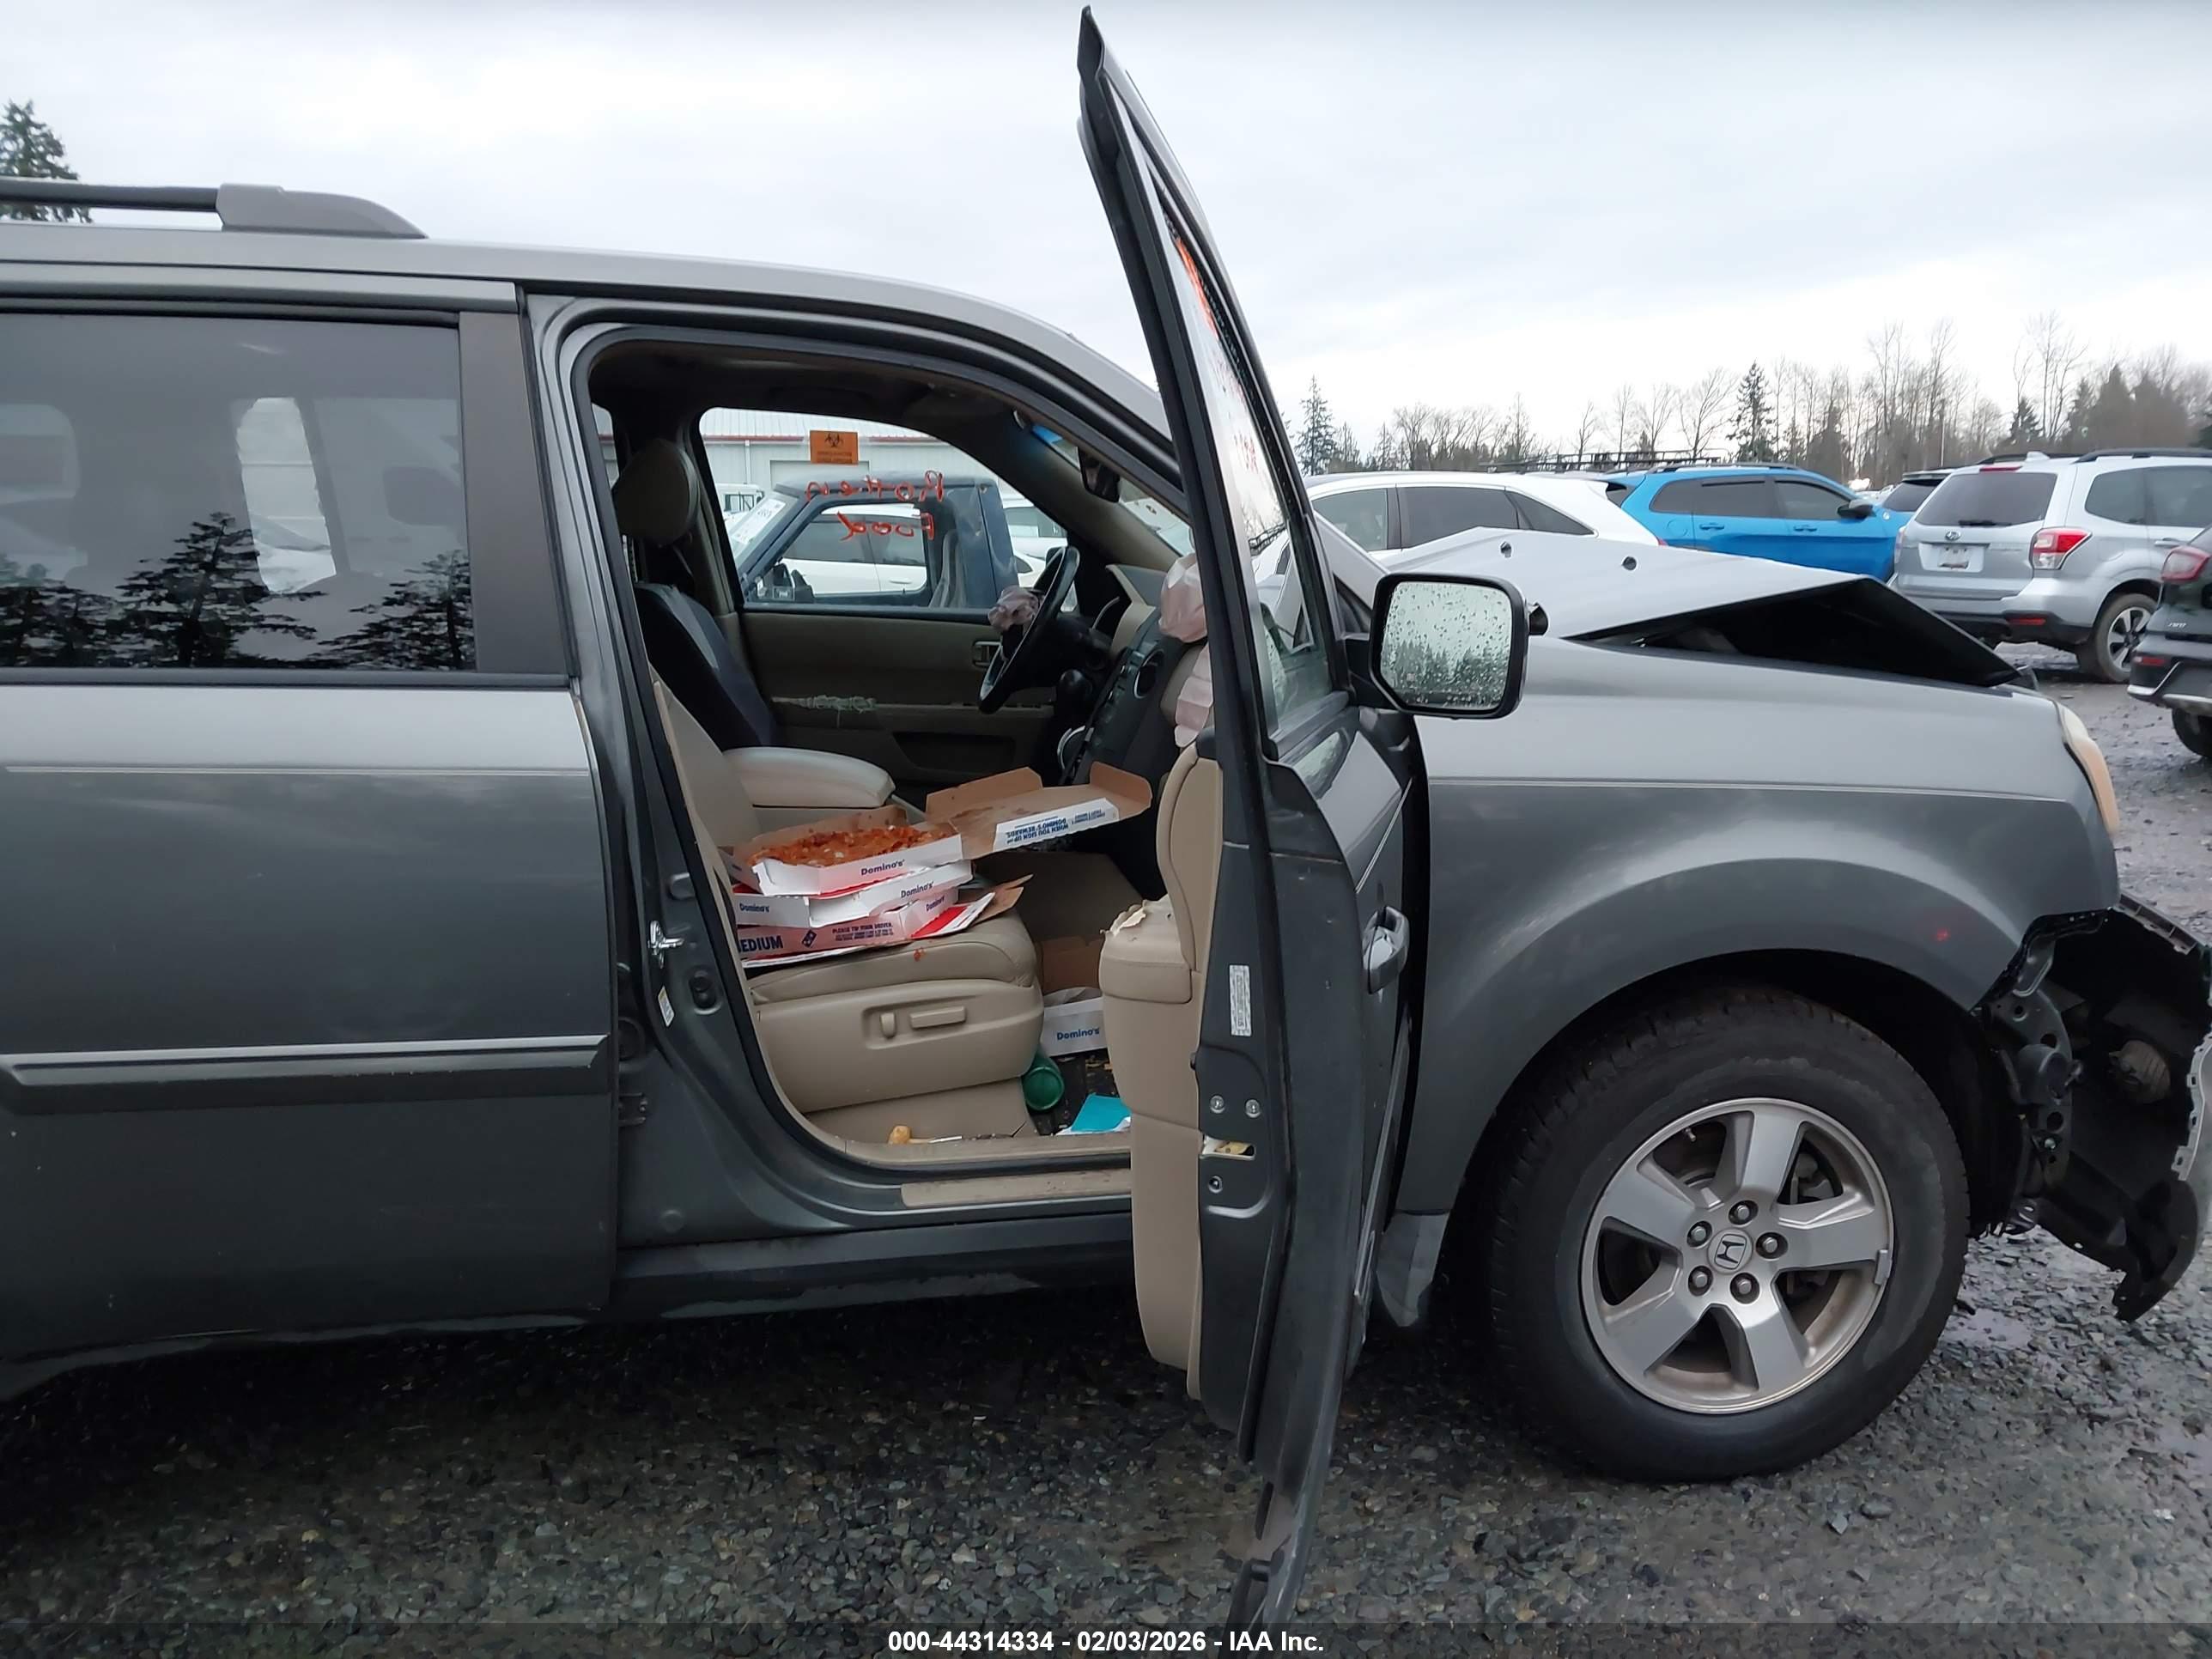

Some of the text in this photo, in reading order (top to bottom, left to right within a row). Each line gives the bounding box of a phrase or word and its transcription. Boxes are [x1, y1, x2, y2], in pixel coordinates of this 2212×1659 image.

[861, 859, 905, 875] Domino's
[900, 881, 934, 898] Domino's
[1057, 1027, 1100, 1040] Domino's
